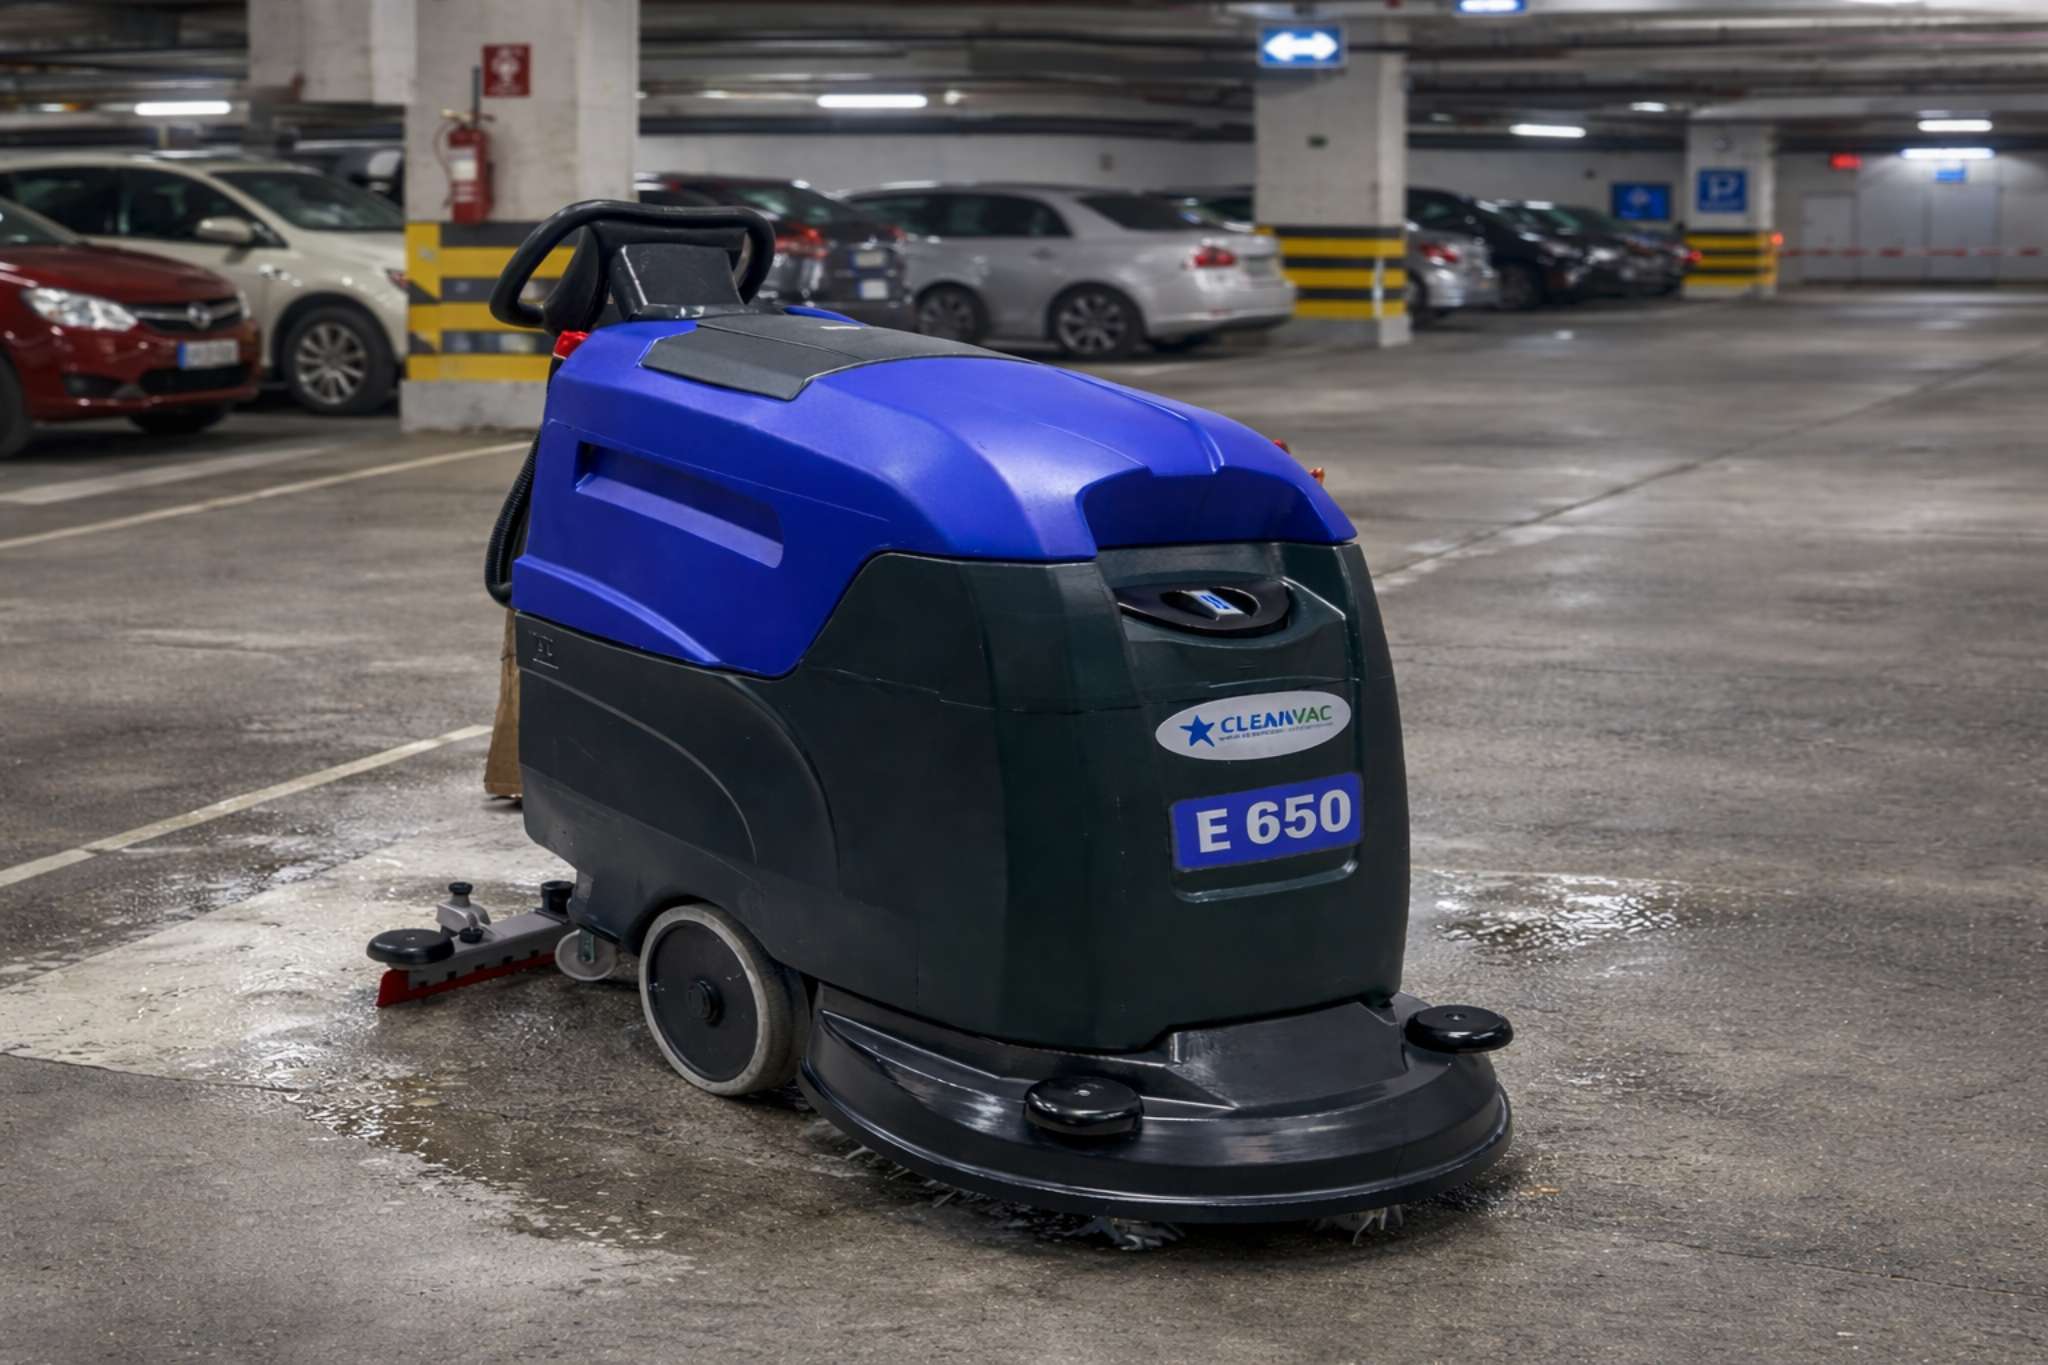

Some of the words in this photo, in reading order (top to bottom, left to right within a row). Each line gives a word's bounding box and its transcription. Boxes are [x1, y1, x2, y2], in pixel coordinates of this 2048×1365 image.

[1709, 175, 1738, 199] P
[1220, 704, 1333, 733] CLEANVAC
[1196, 808, 1231, 853] E
[1246, 789, 1351, 844] 650
